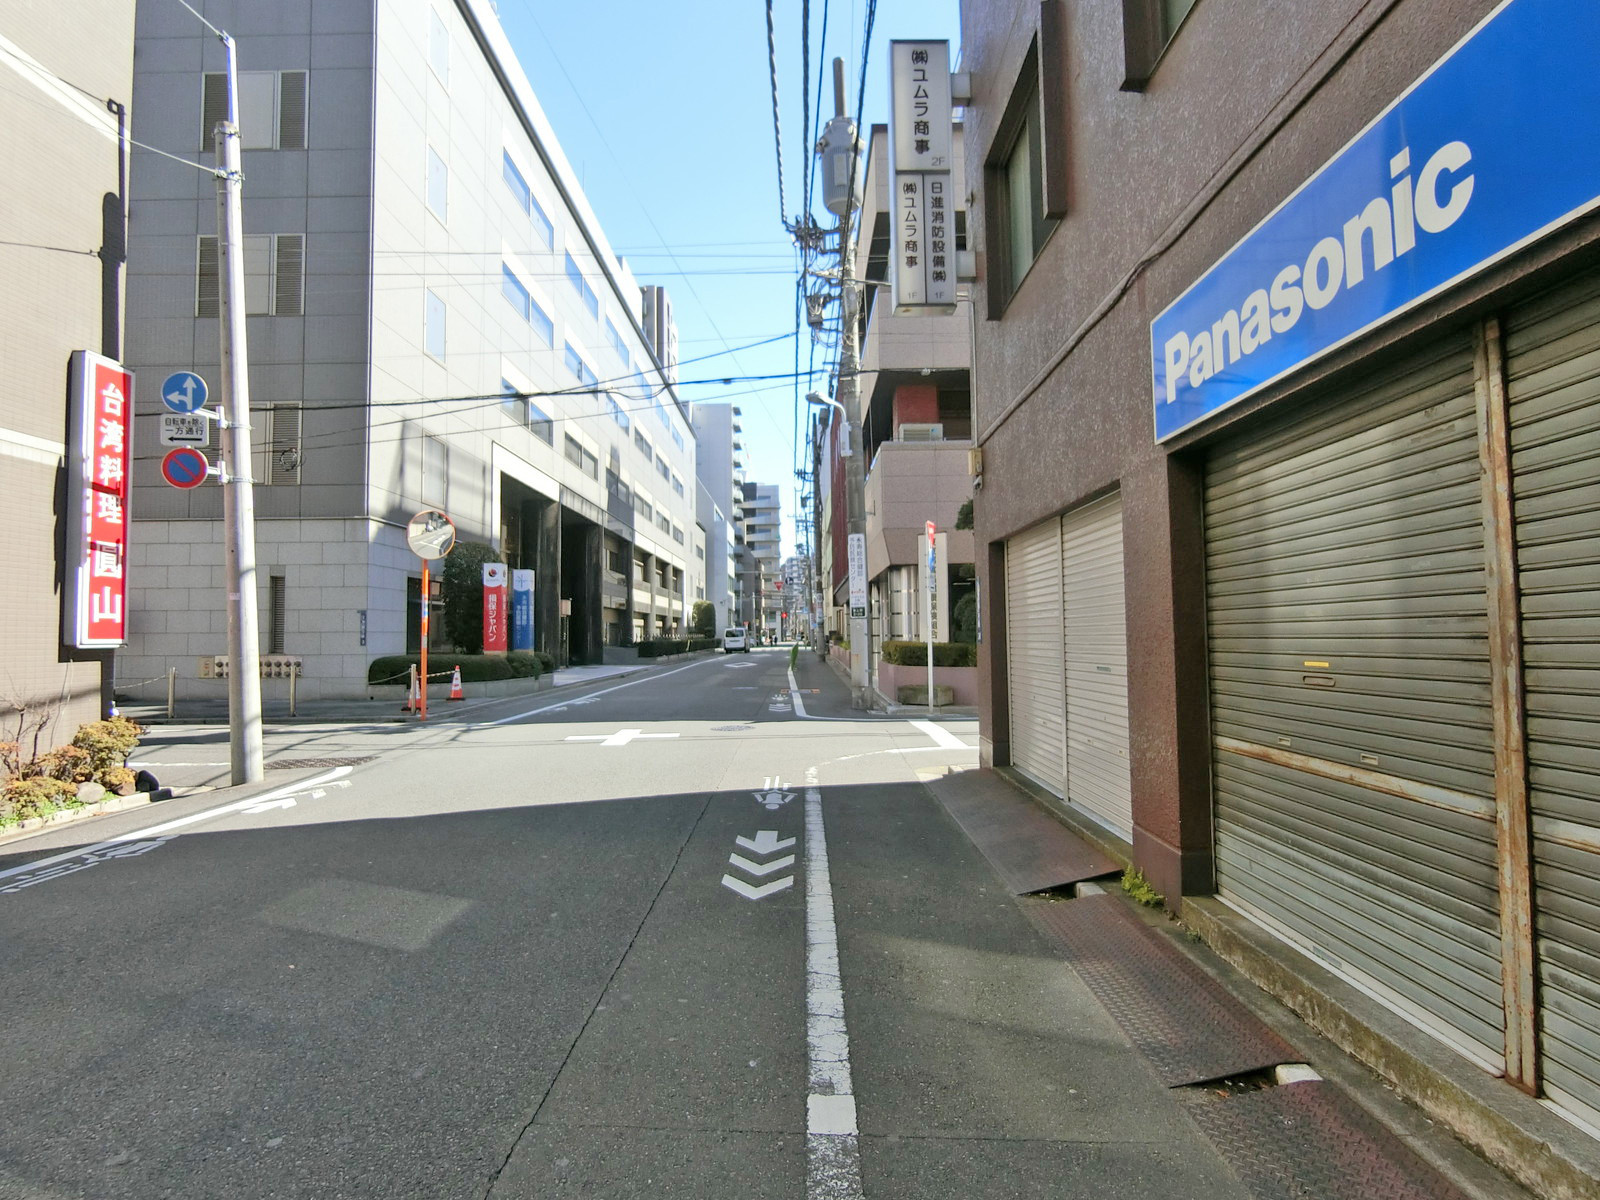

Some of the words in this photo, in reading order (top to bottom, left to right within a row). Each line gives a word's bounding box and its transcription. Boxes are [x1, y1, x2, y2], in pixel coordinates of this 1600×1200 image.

[931, 157, 945, 166] 2F
[1164, 140, 1475, 405] Panasonic
[907, 291, 918, 299] 1F
[935, 291, 944, 299] 1F
[164, 417, 204, 427] 自転車を除く
[165, 427, 204, 436] 一方通行
